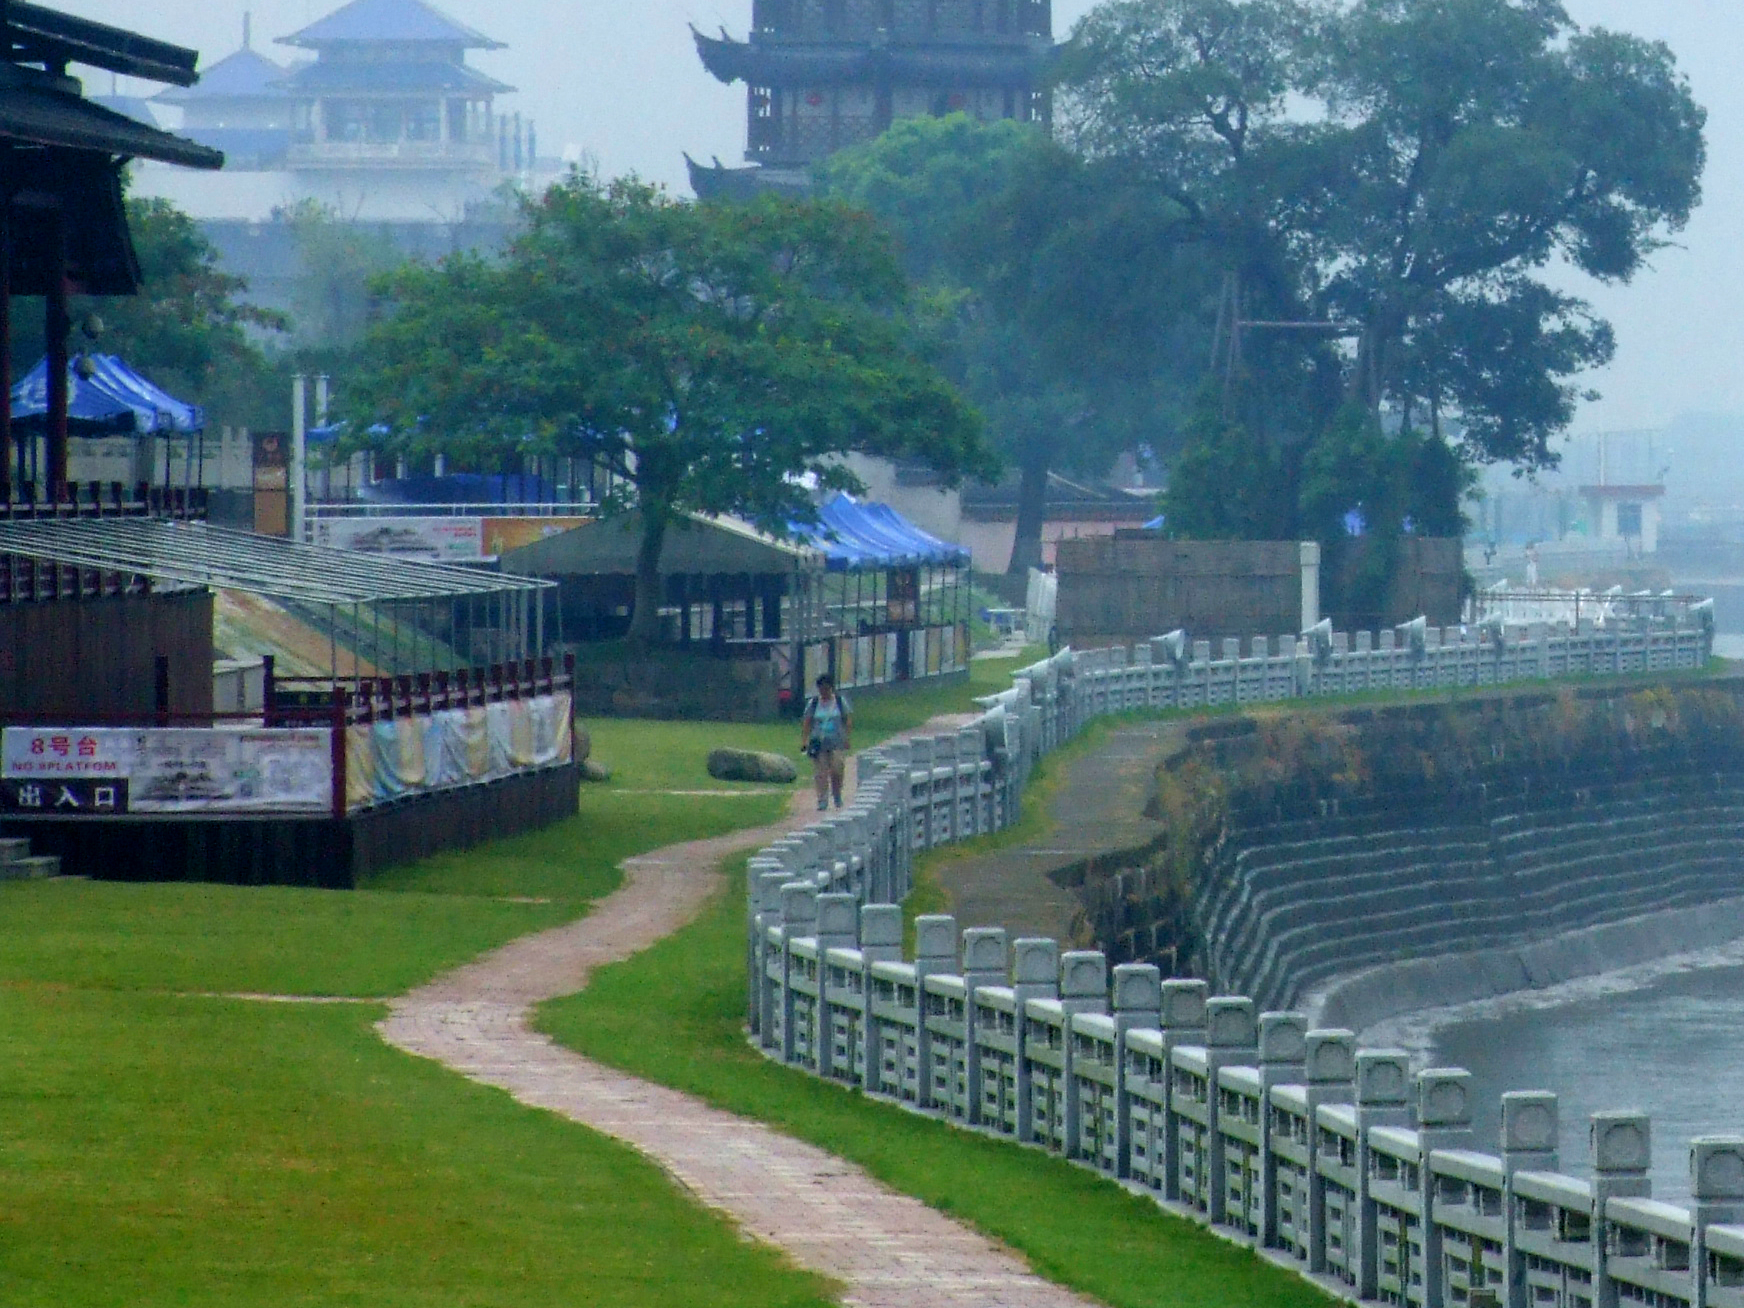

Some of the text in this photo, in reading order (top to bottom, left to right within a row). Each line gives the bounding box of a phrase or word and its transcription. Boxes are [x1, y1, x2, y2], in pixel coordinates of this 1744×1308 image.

[31, 736, 97, 757] 8号台
[18, 784, 115, 808] 出入口
